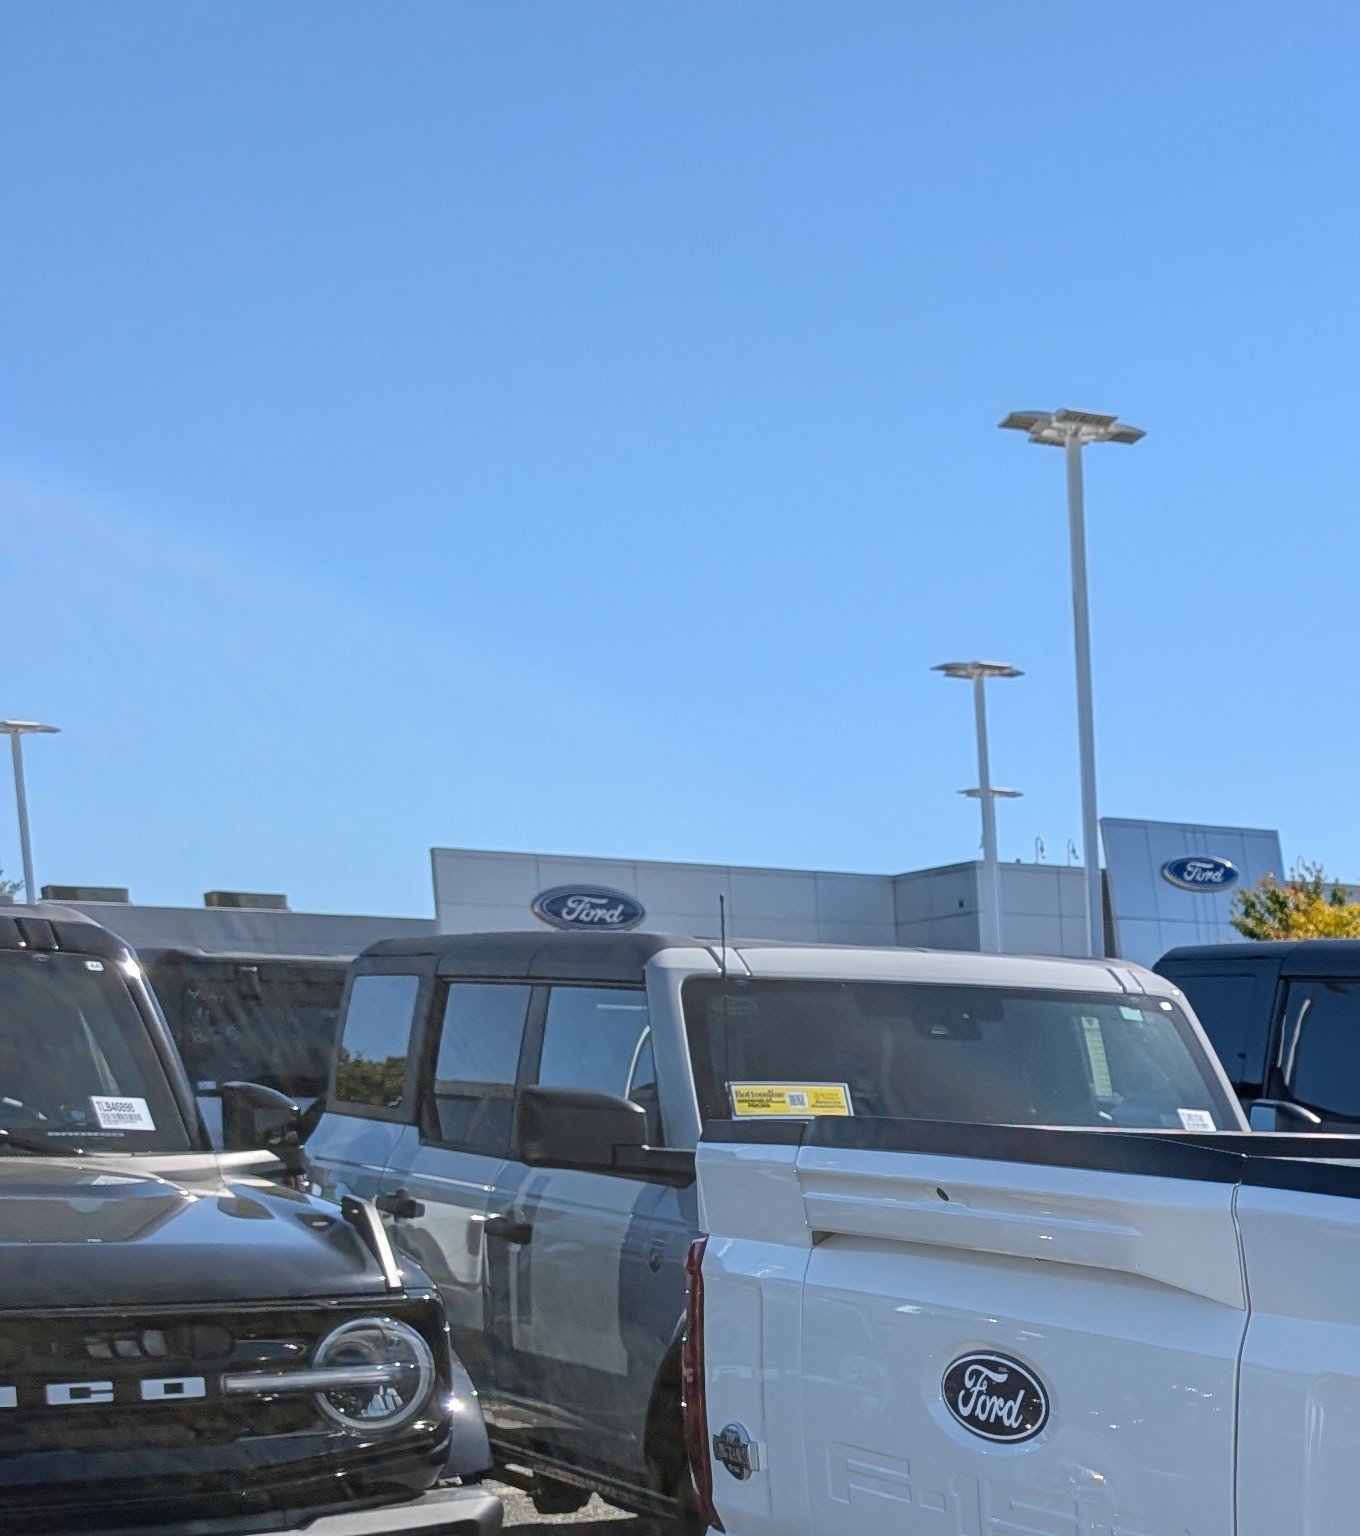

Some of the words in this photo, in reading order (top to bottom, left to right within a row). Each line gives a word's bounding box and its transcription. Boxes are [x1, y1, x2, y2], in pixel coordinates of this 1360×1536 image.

[1183, 861, 1224, 882] Ford
[561, 895, 624, 922] Ford
[0, 1376, 206, 1408] CO
[957, 1364, 1026, 1429] Ford
